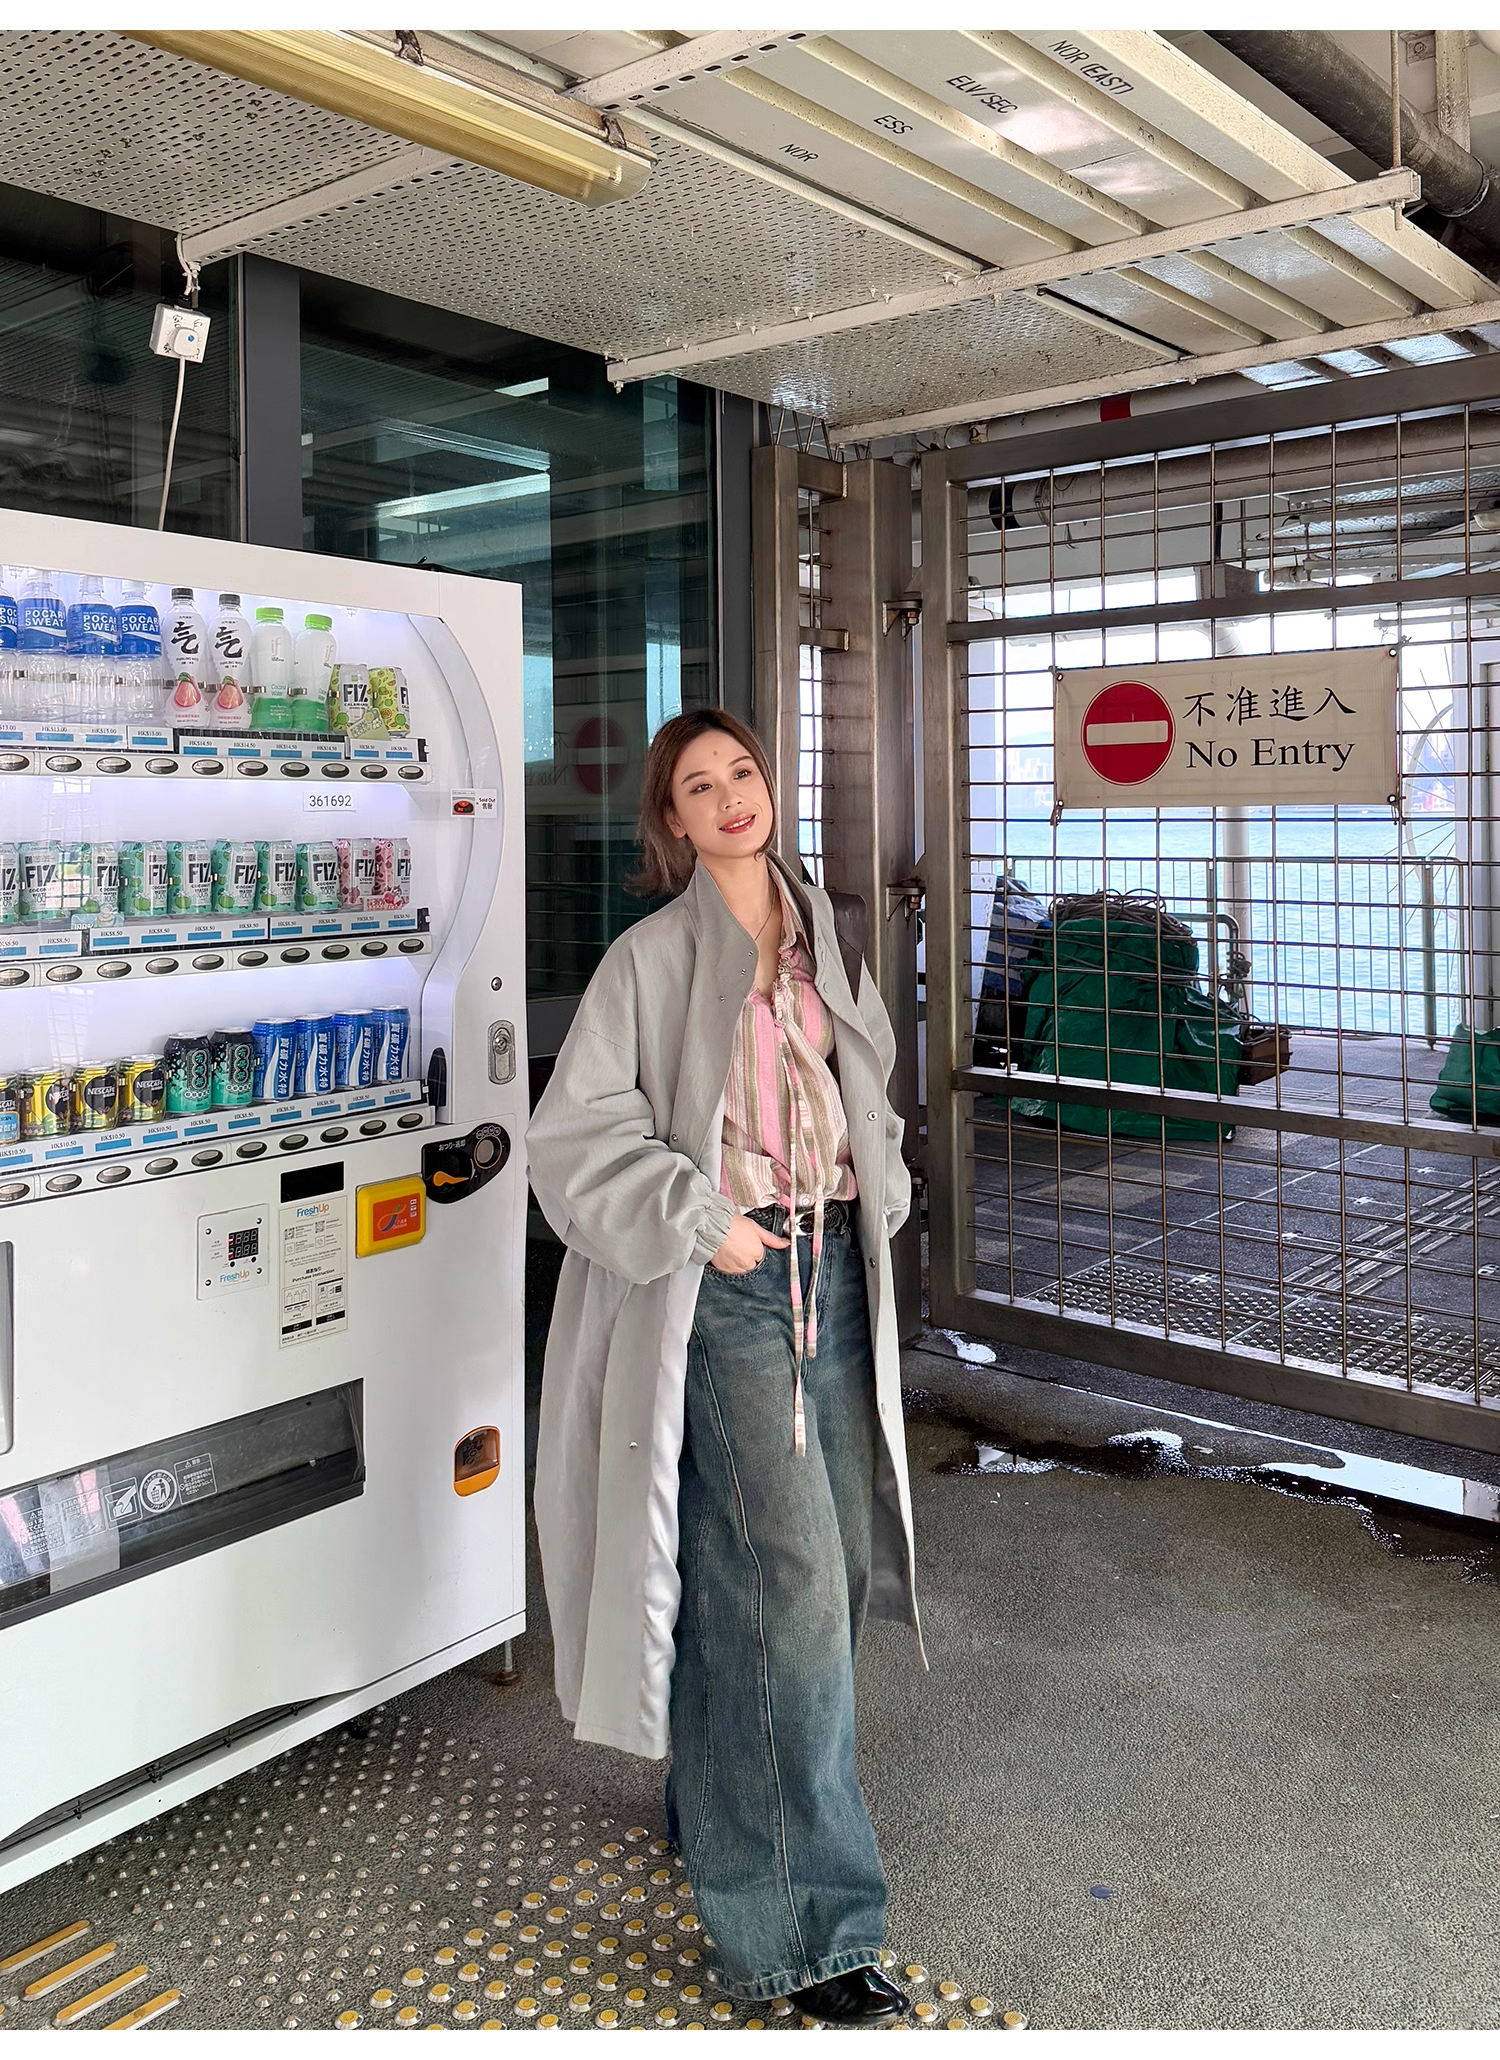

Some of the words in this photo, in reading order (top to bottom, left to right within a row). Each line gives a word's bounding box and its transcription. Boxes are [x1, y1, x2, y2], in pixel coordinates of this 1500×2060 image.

[1048, 39, 1090, 64] NOR
[1080, 61, 1135, 95] (EAST)
[945, 74, 1019, 115] ELV/SEC
[873, 114, 914, 136] ESS
[778, 142, 819, 163] NOR
[25, 617, 64, 628] SWEAT
[1182, 684, 1357, 727] 不准進入
[1186, 741, 1238, 769] No
[1250, 738, 1356, 772] Entry
[309, 794, 352, 807] 361692
[296, 1203, 330, 1218] FreshUp
[219, 1269, 250, 1284] FreshUp
